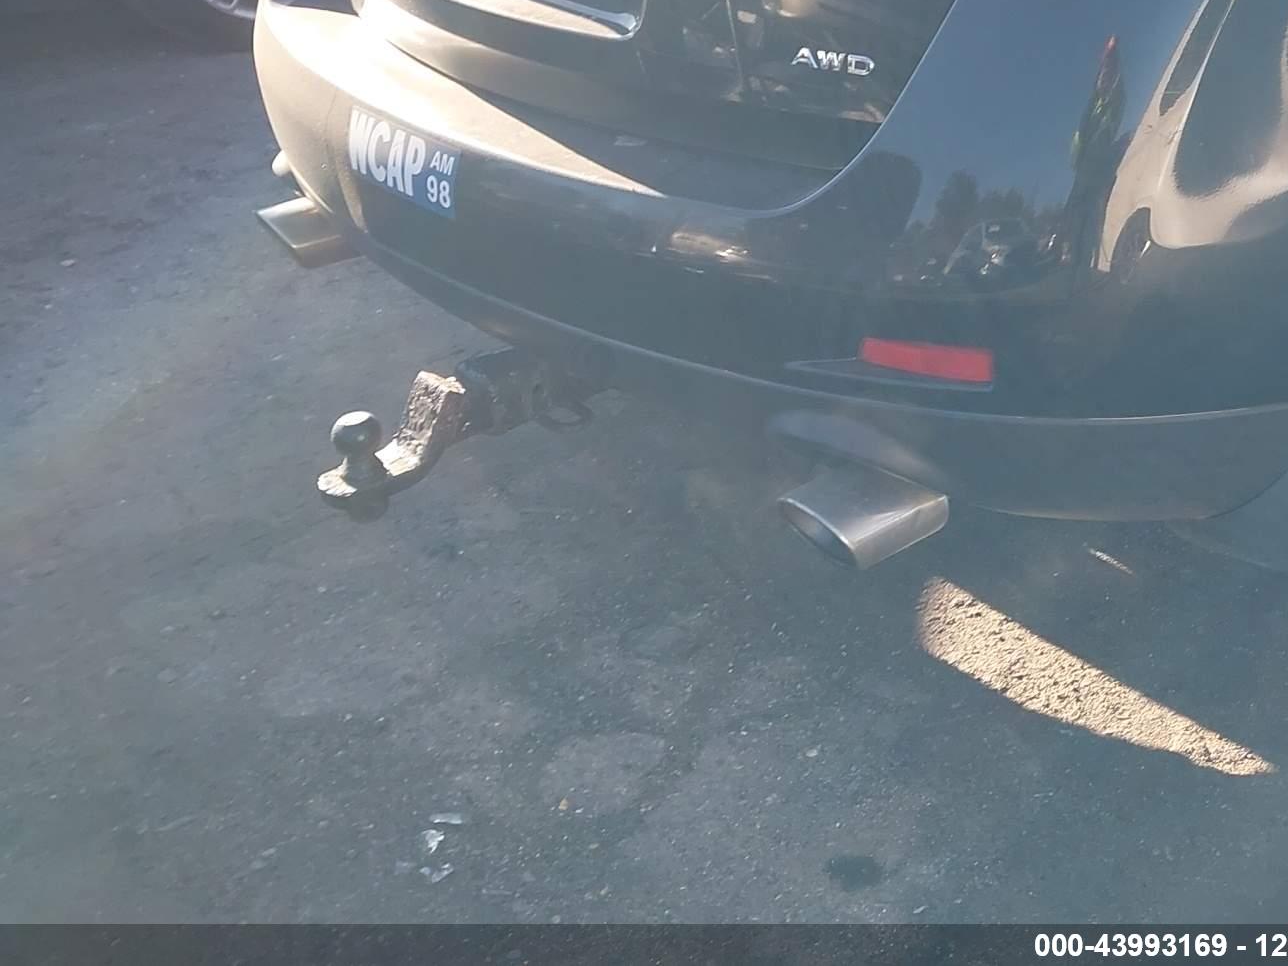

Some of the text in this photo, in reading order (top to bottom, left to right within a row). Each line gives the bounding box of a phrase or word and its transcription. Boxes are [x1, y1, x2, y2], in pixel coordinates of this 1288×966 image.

[791, 46, 875, 76] AWD
[350, 109, 426, 196] WCAP
[430, 151, 455, 176] AM
[427, 175, 451, 209] 98
